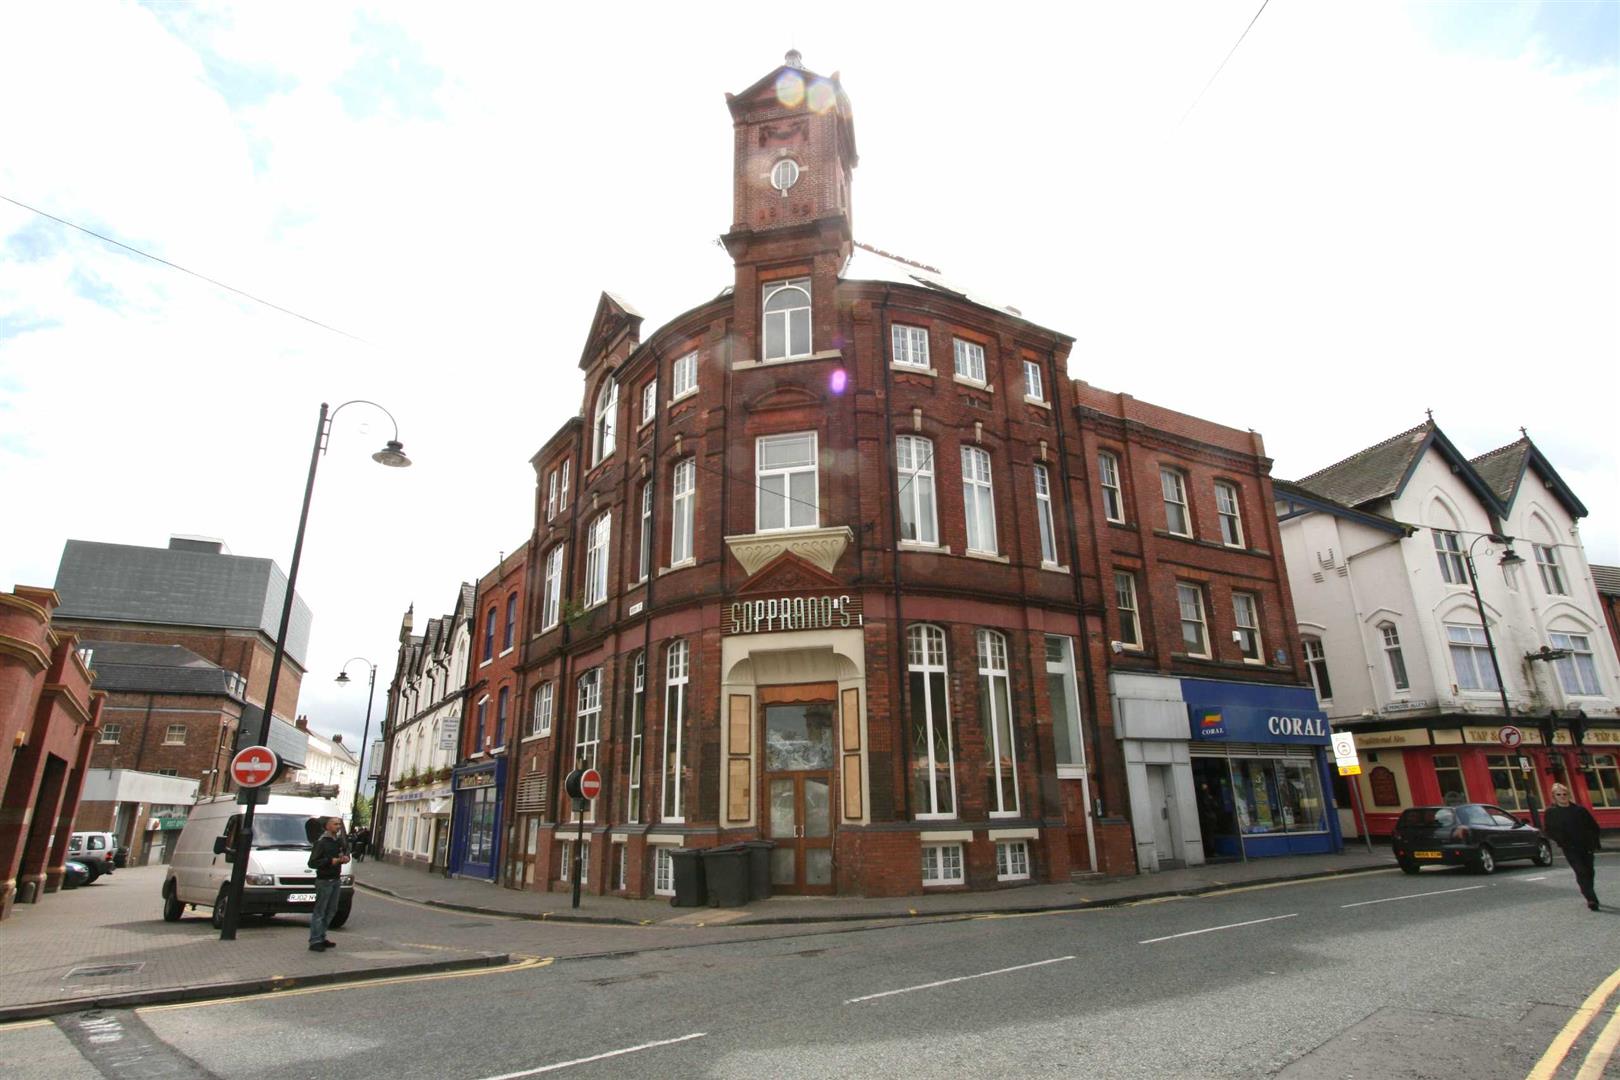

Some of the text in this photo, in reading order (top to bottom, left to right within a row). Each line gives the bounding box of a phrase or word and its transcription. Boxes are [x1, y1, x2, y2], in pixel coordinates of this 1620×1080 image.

[731, 595, 850, 634] SOPPRANO'S
[1201, 728, 1225, 736] CORAL
[1268, 716, 1325, 737] CORAL
[1468, 730, 1487, 742] TAP
